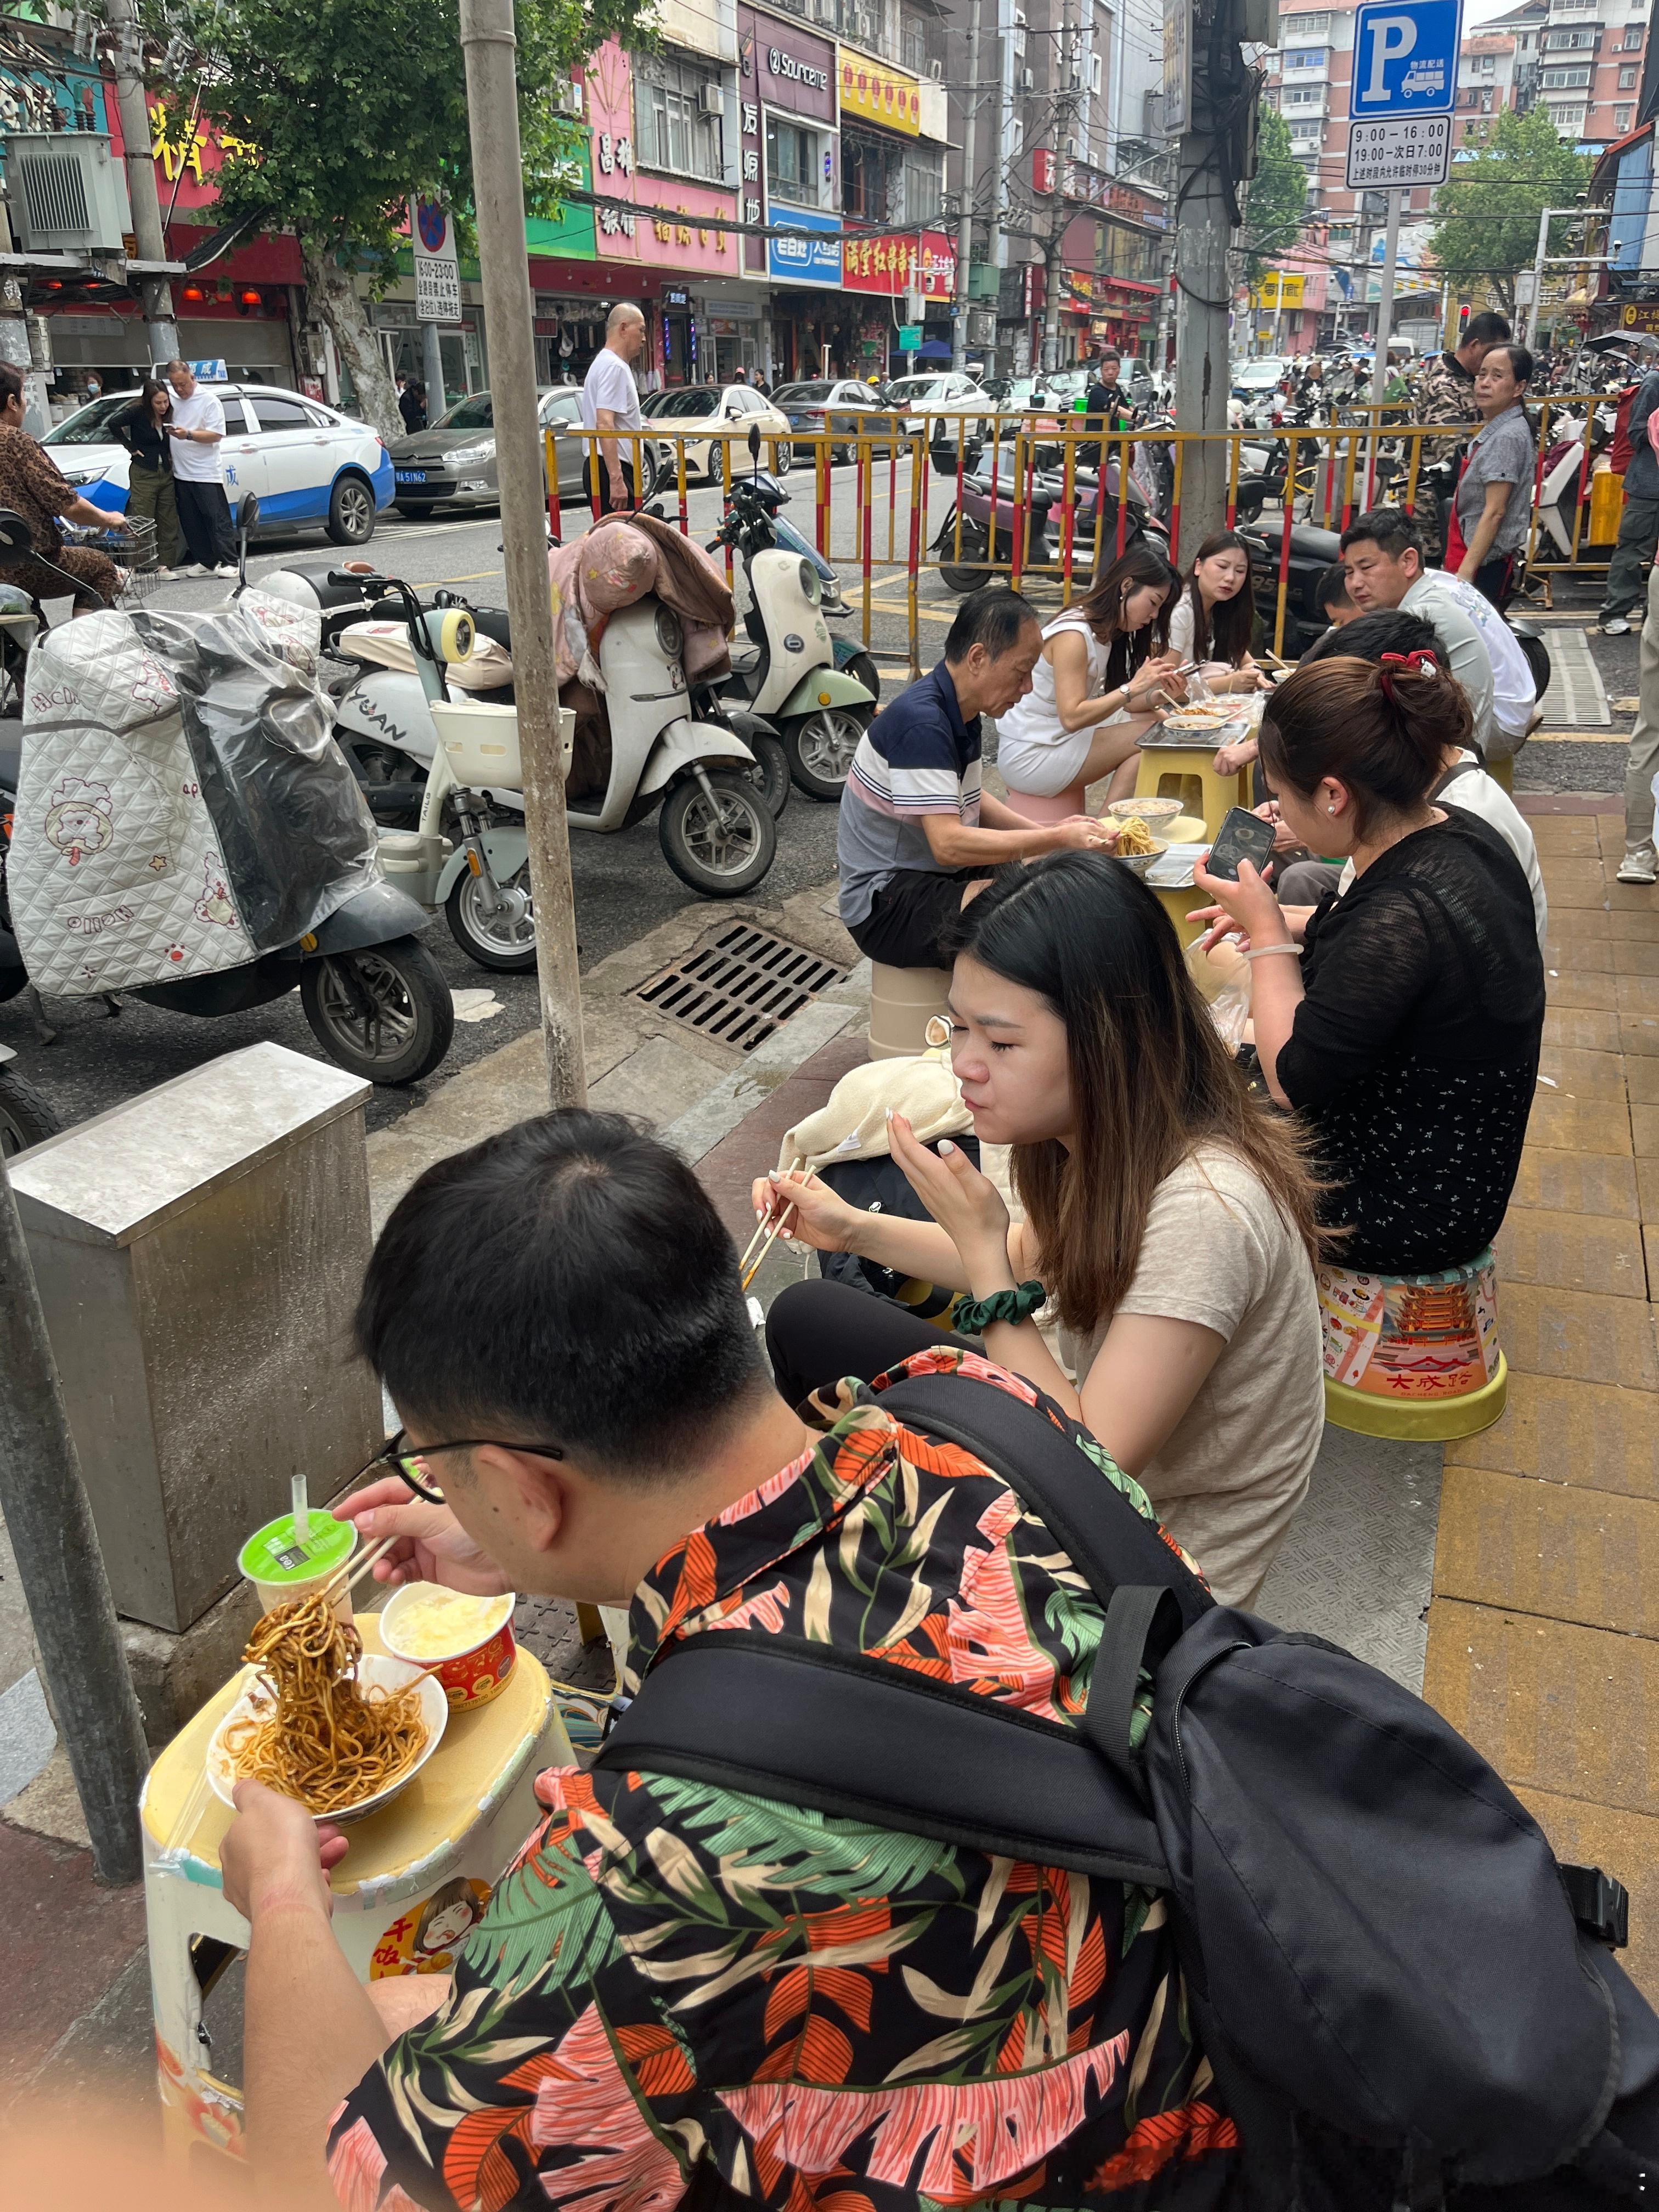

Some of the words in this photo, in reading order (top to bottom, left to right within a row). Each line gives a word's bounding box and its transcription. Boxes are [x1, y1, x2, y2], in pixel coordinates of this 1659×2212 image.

[1362, 16, 1417, 102] P
[1410, 59, 1444, 70] 物流配送
[225, 465, 239, 487] 成
[1386, 1370, 1473, 1391] 大成路
